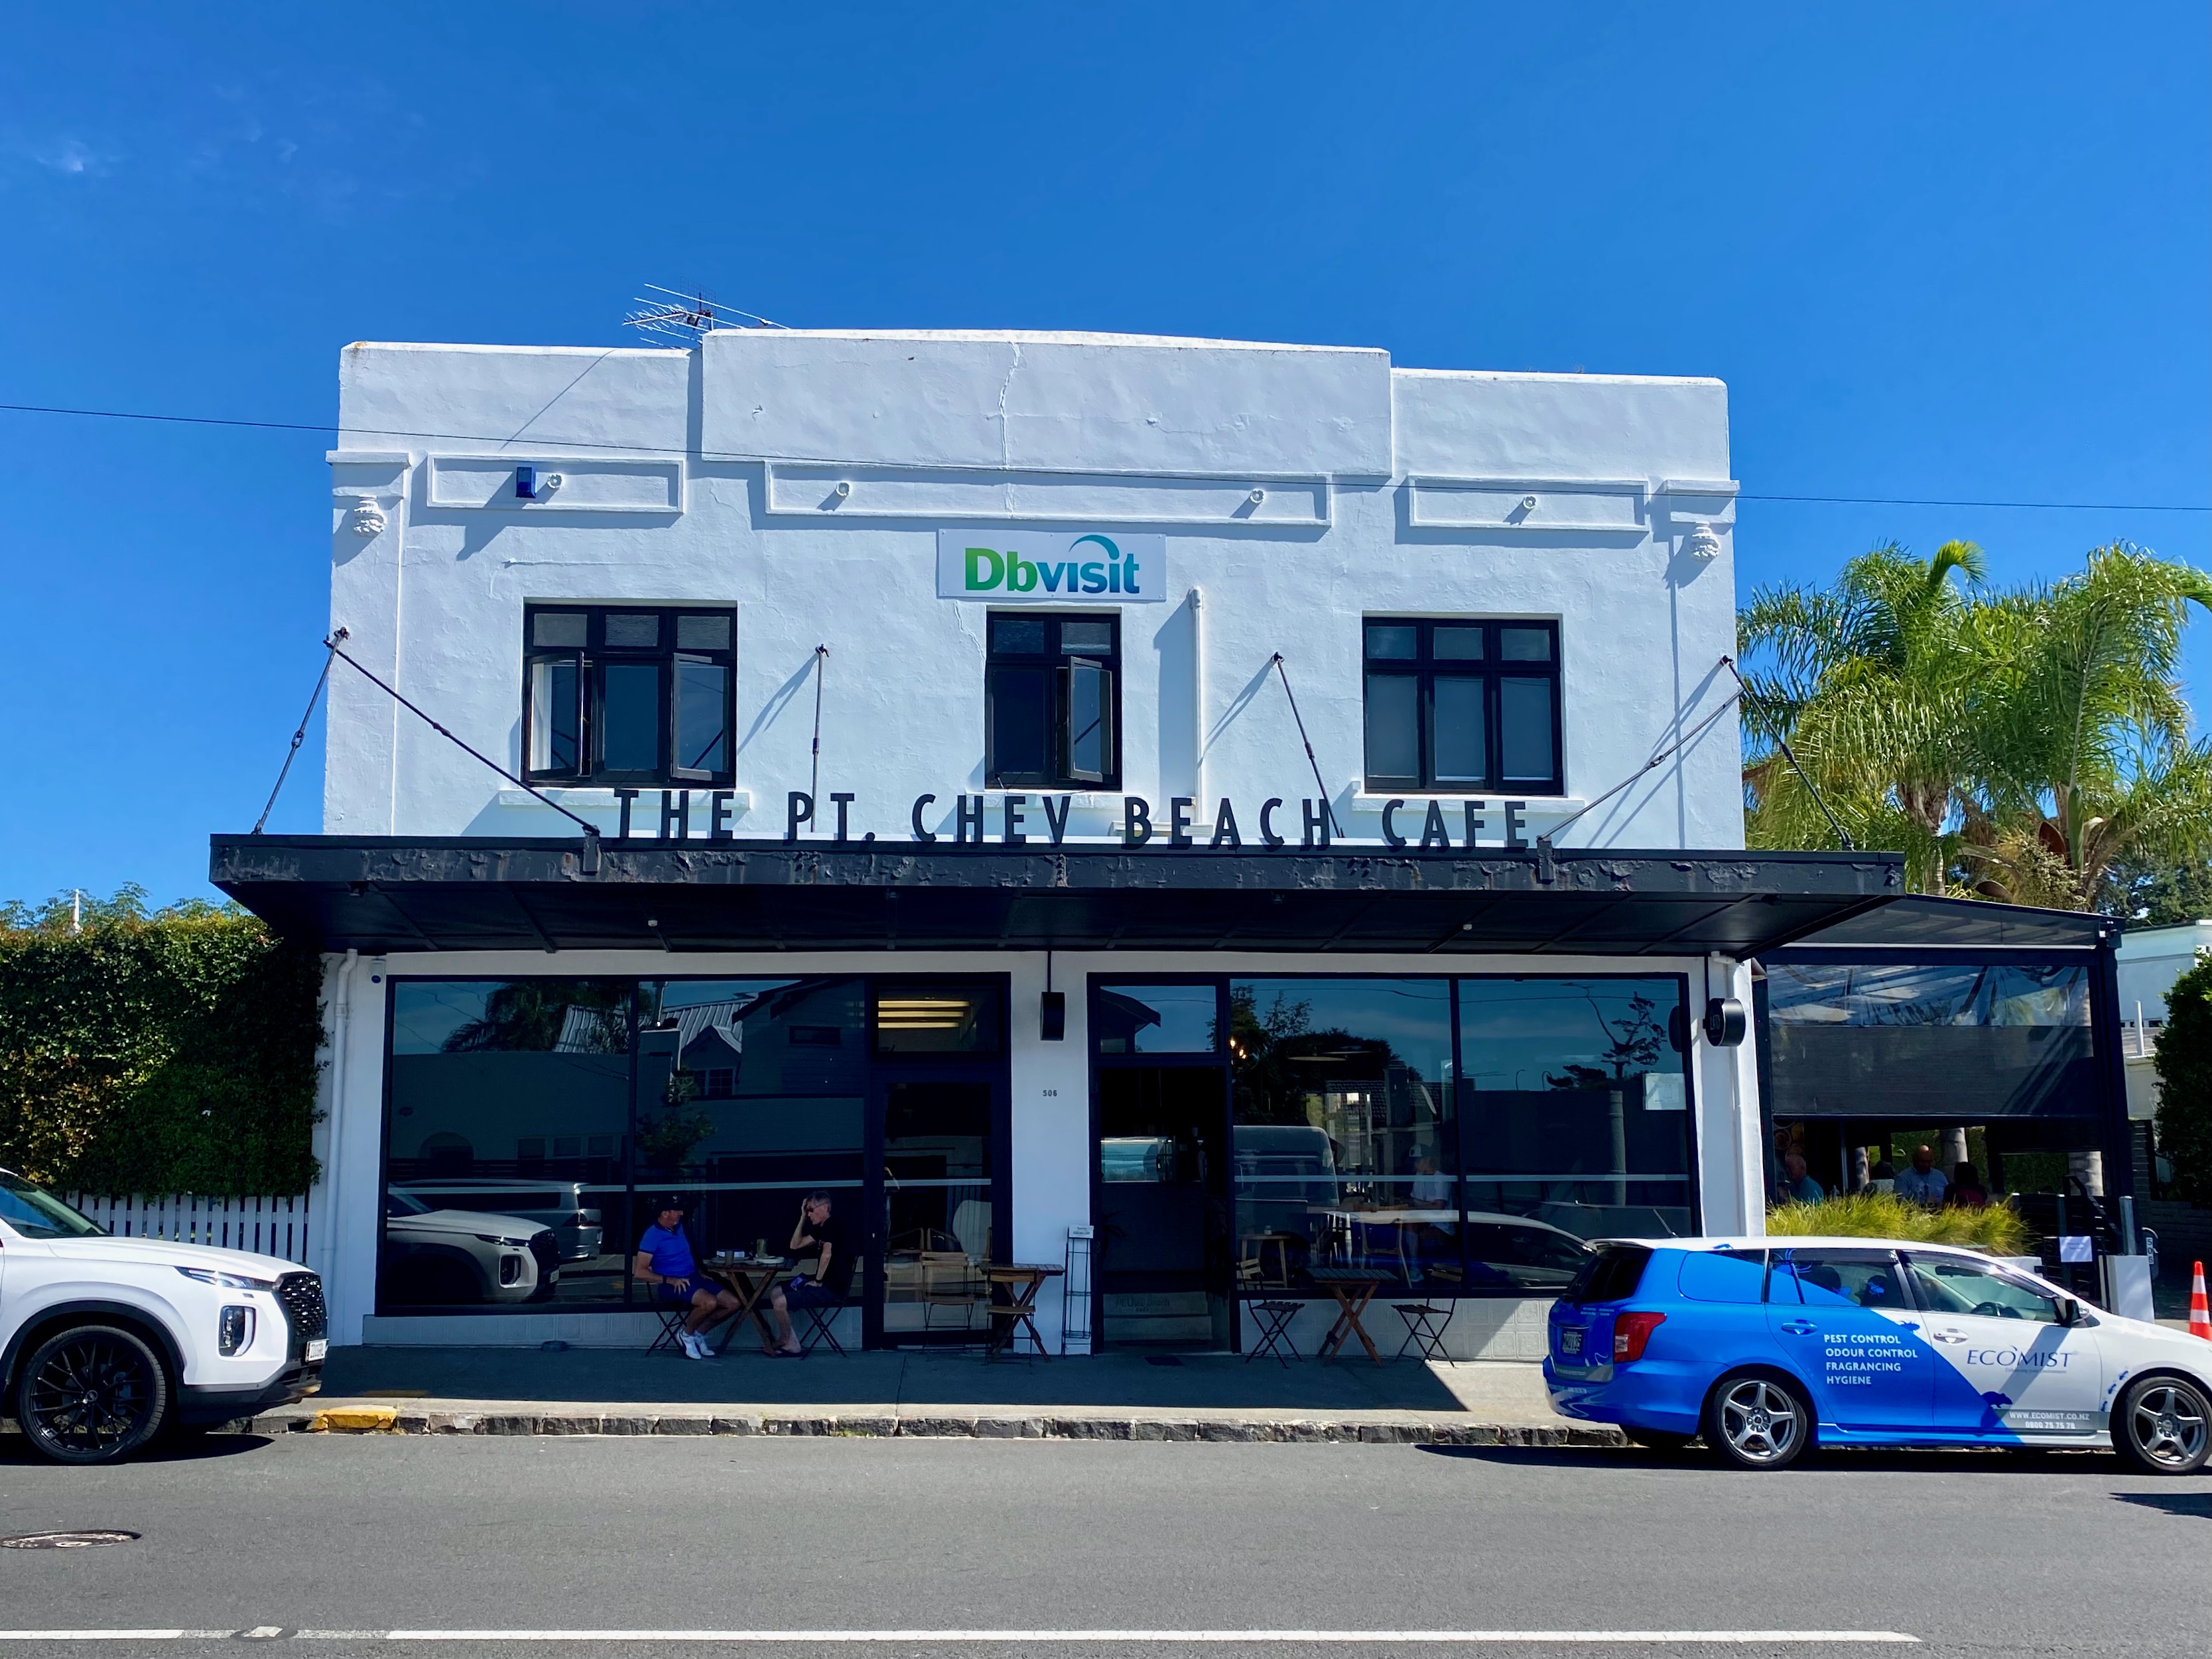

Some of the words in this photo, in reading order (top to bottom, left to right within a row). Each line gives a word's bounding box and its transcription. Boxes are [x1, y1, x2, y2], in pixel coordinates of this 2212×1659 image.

[964, 534, 1140, 594] Dbvisit
[614, 790, 734, 839] THE
[788, 792, 876, 843] PT.
[912, 794, 1071, 844] CHEV
[1122, 797, 1329, 850] BEACH
[1382, 798, 1529, 851] CAFE
[1824, 1334, 1847, 1343] PEST
[1851, 1335, 1901, 1344] CONTROL
[1825, 1348, 1865, 1357] ODOUR
[1868, 1349, 1918, 1358] CONTROL
[1967, 1348, 2073, 1367] ECOMIST
[1826, 1362, 1901, 1371] FRAGRANCING
[1827, 1376, 1872, 1385] HYGIENE
[2009, 1412, 2090, 1420] WWW.ECOMIST.CO.NZ
